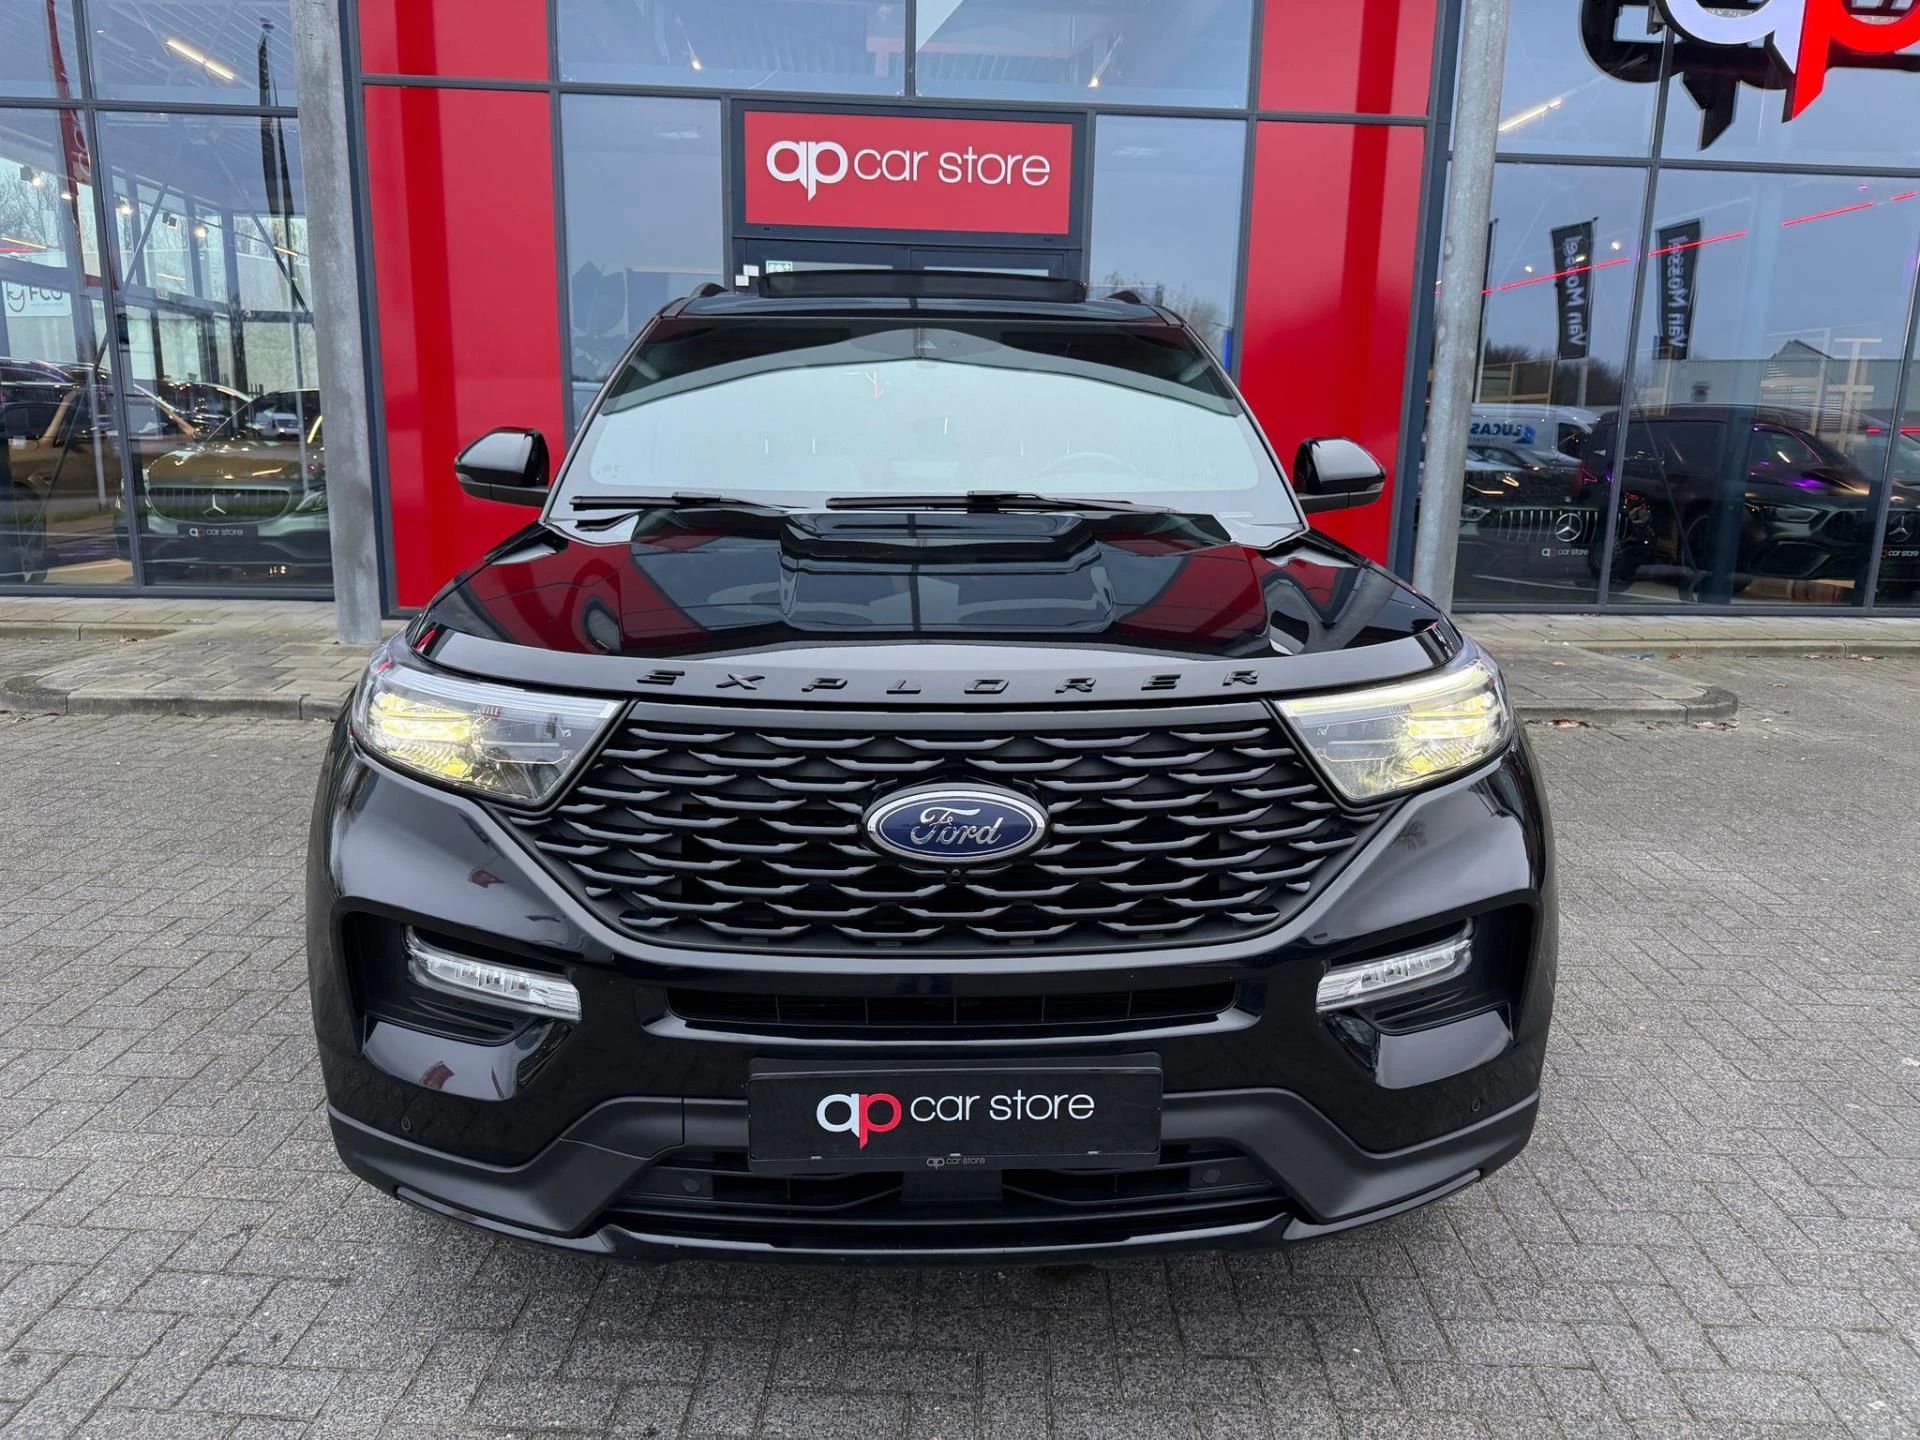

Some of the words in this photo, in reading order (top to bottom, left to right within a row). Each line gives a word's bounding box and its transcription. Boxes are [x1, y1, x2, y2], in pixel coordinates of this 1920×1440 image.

[854, 149, 929, 181] car
[938, 146, 1050, 186] store
[221, 527, 243, 536] store
[1571, 548, 1589, 556] store
[637, 669, 1258, 695] EXPLORER
[910, 807, 1004, 845] Ford
[910, 1095, 980, 1122] car
[989, 1089, 1095, 1121] store
[962, 1157, 986, 1165] store
